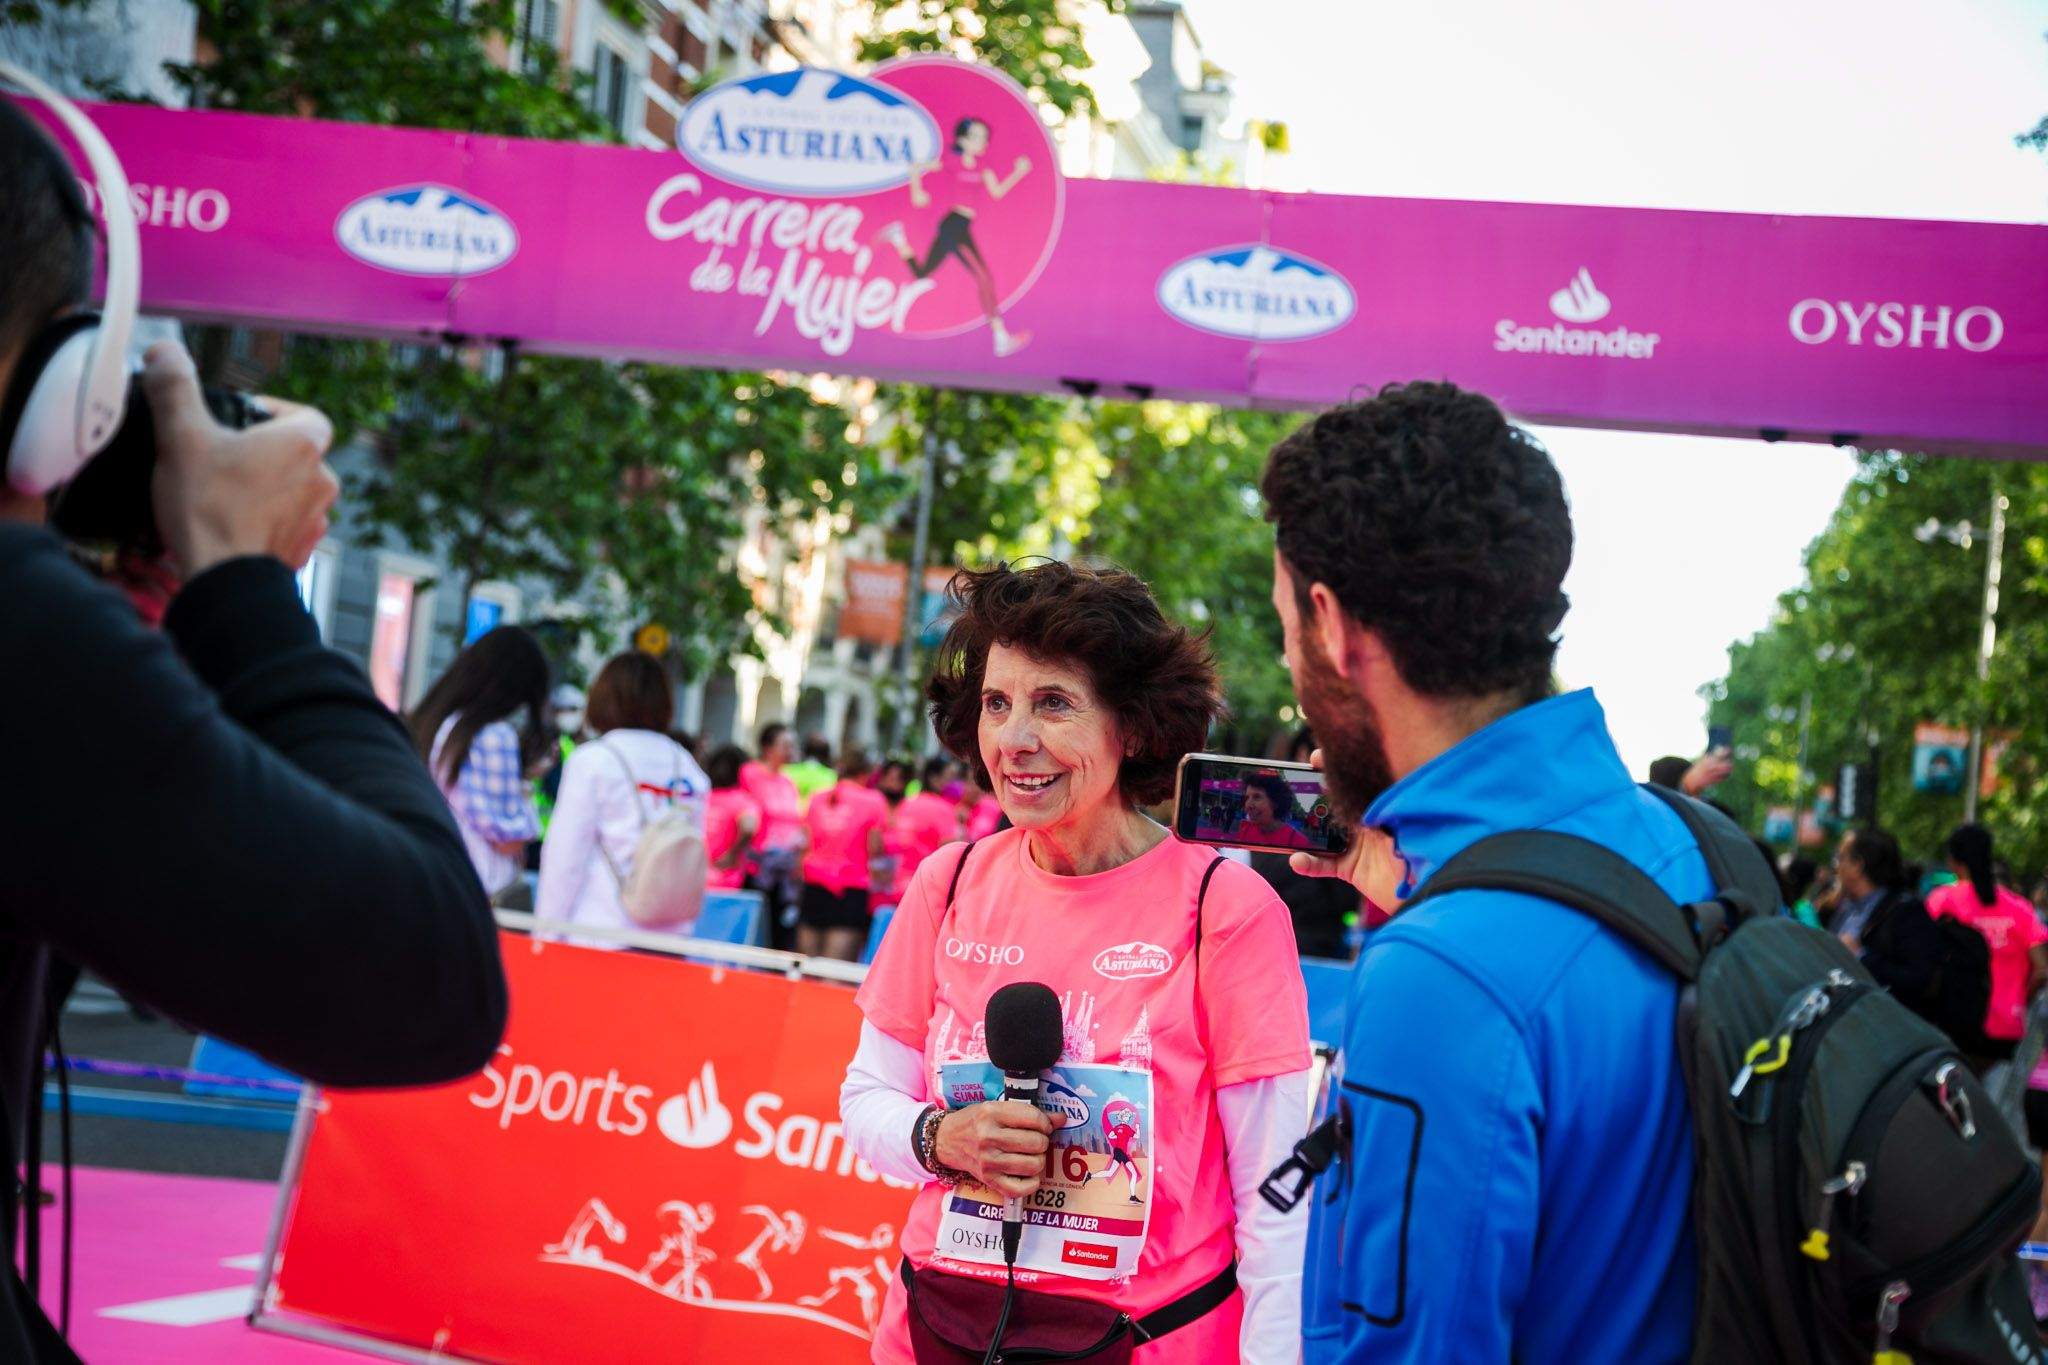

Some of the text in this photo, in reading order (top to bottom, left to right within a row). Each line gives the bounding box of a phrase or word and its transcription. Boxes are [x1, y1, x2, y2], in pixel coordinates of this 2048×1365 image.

[699, 109, 914, 162] ASTURIANA
[646, 172, 864, 254] Carrera
[690, 245, 773, 297] de la
[753, 247, 937, 356] Mujer
[1493, 319, 1660, 359] Santander
[1788, 298, 2005, 353] OYSHO
[945, 937, 1024, 966] OYSHO
[468, 1043, 654, 1136] Sports
[954, 1091, 986, 1103] SUMA
[961, 1082, 985, 1091] DORSAL
[1031, 1211, 1045, 1224] DE
[1046, 1214, 1060, 1226] LA
[1062, 1214, 1099, 1231] MUJER
[1076, 1250, 1110, 1261] Santander
